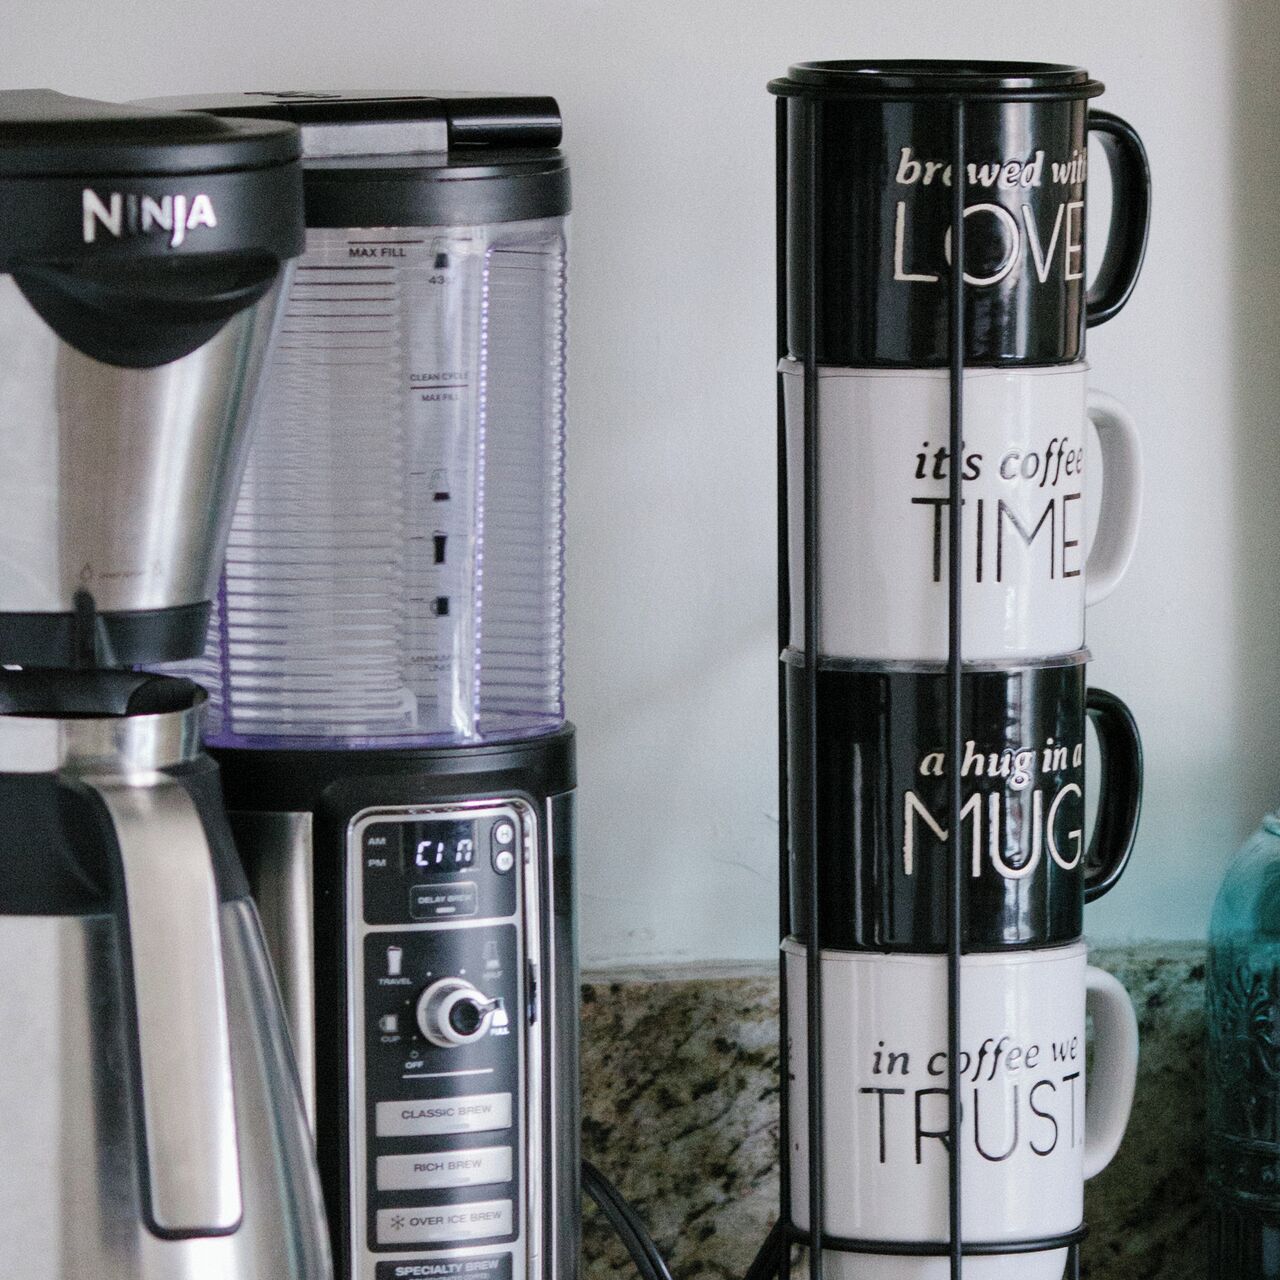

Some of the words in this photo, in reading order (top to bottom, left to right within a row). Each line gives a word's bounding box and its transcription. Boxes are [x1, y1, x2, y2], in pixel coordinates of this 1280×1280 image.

[82, 187, 218, 249] NINJA
[893, 200, 1084, 286] LOVE
[349, 248, 377, 258] MAX
[381, 248, 407, 257] FILL
[409, 373, 440, 381] CLEAN
[421, 394, 441, 402] MAX
[915, 441, 983, 481] it's
[1000, 436, 1083, 488] coffee
[911, 492, 1082, 583] TIME
[919, 752, 946, 776] a
[960, 740, 1037, 791] hug
[1042, 737, 1068, 773] in
[1072, 743, 1083, 768] a
[368, 837, 387, 846] AM
[368, 859, 387, 868] PM
[417, 895, 446, 905] DELAY
[378, 977, 413, 986] TRAVEL
[381, 1035, 401, 1043] CUP
[405, 1060, 424, 1069] OFF
[872, 1040, 910, 1075] in
[927, 1036, 1040, 1082] coffee
[1052, 1036, 1078, 1062] we
[401, 1107, 455, 1120] CLASSIC
[458, 1104, 493, 1115] BREW
[414, 1162, 444, 1172] RICH
[448, 1159, 482, 1170] BREW
[409, 1216, 444, 1227] OVER
[447, 1214, 467, 1224] ICE
[470, 1211, 502, 1222] BREW
[394, 1263, 463, 1277] SPECIALTY
[465, 1259, 500, 1270] BREW
